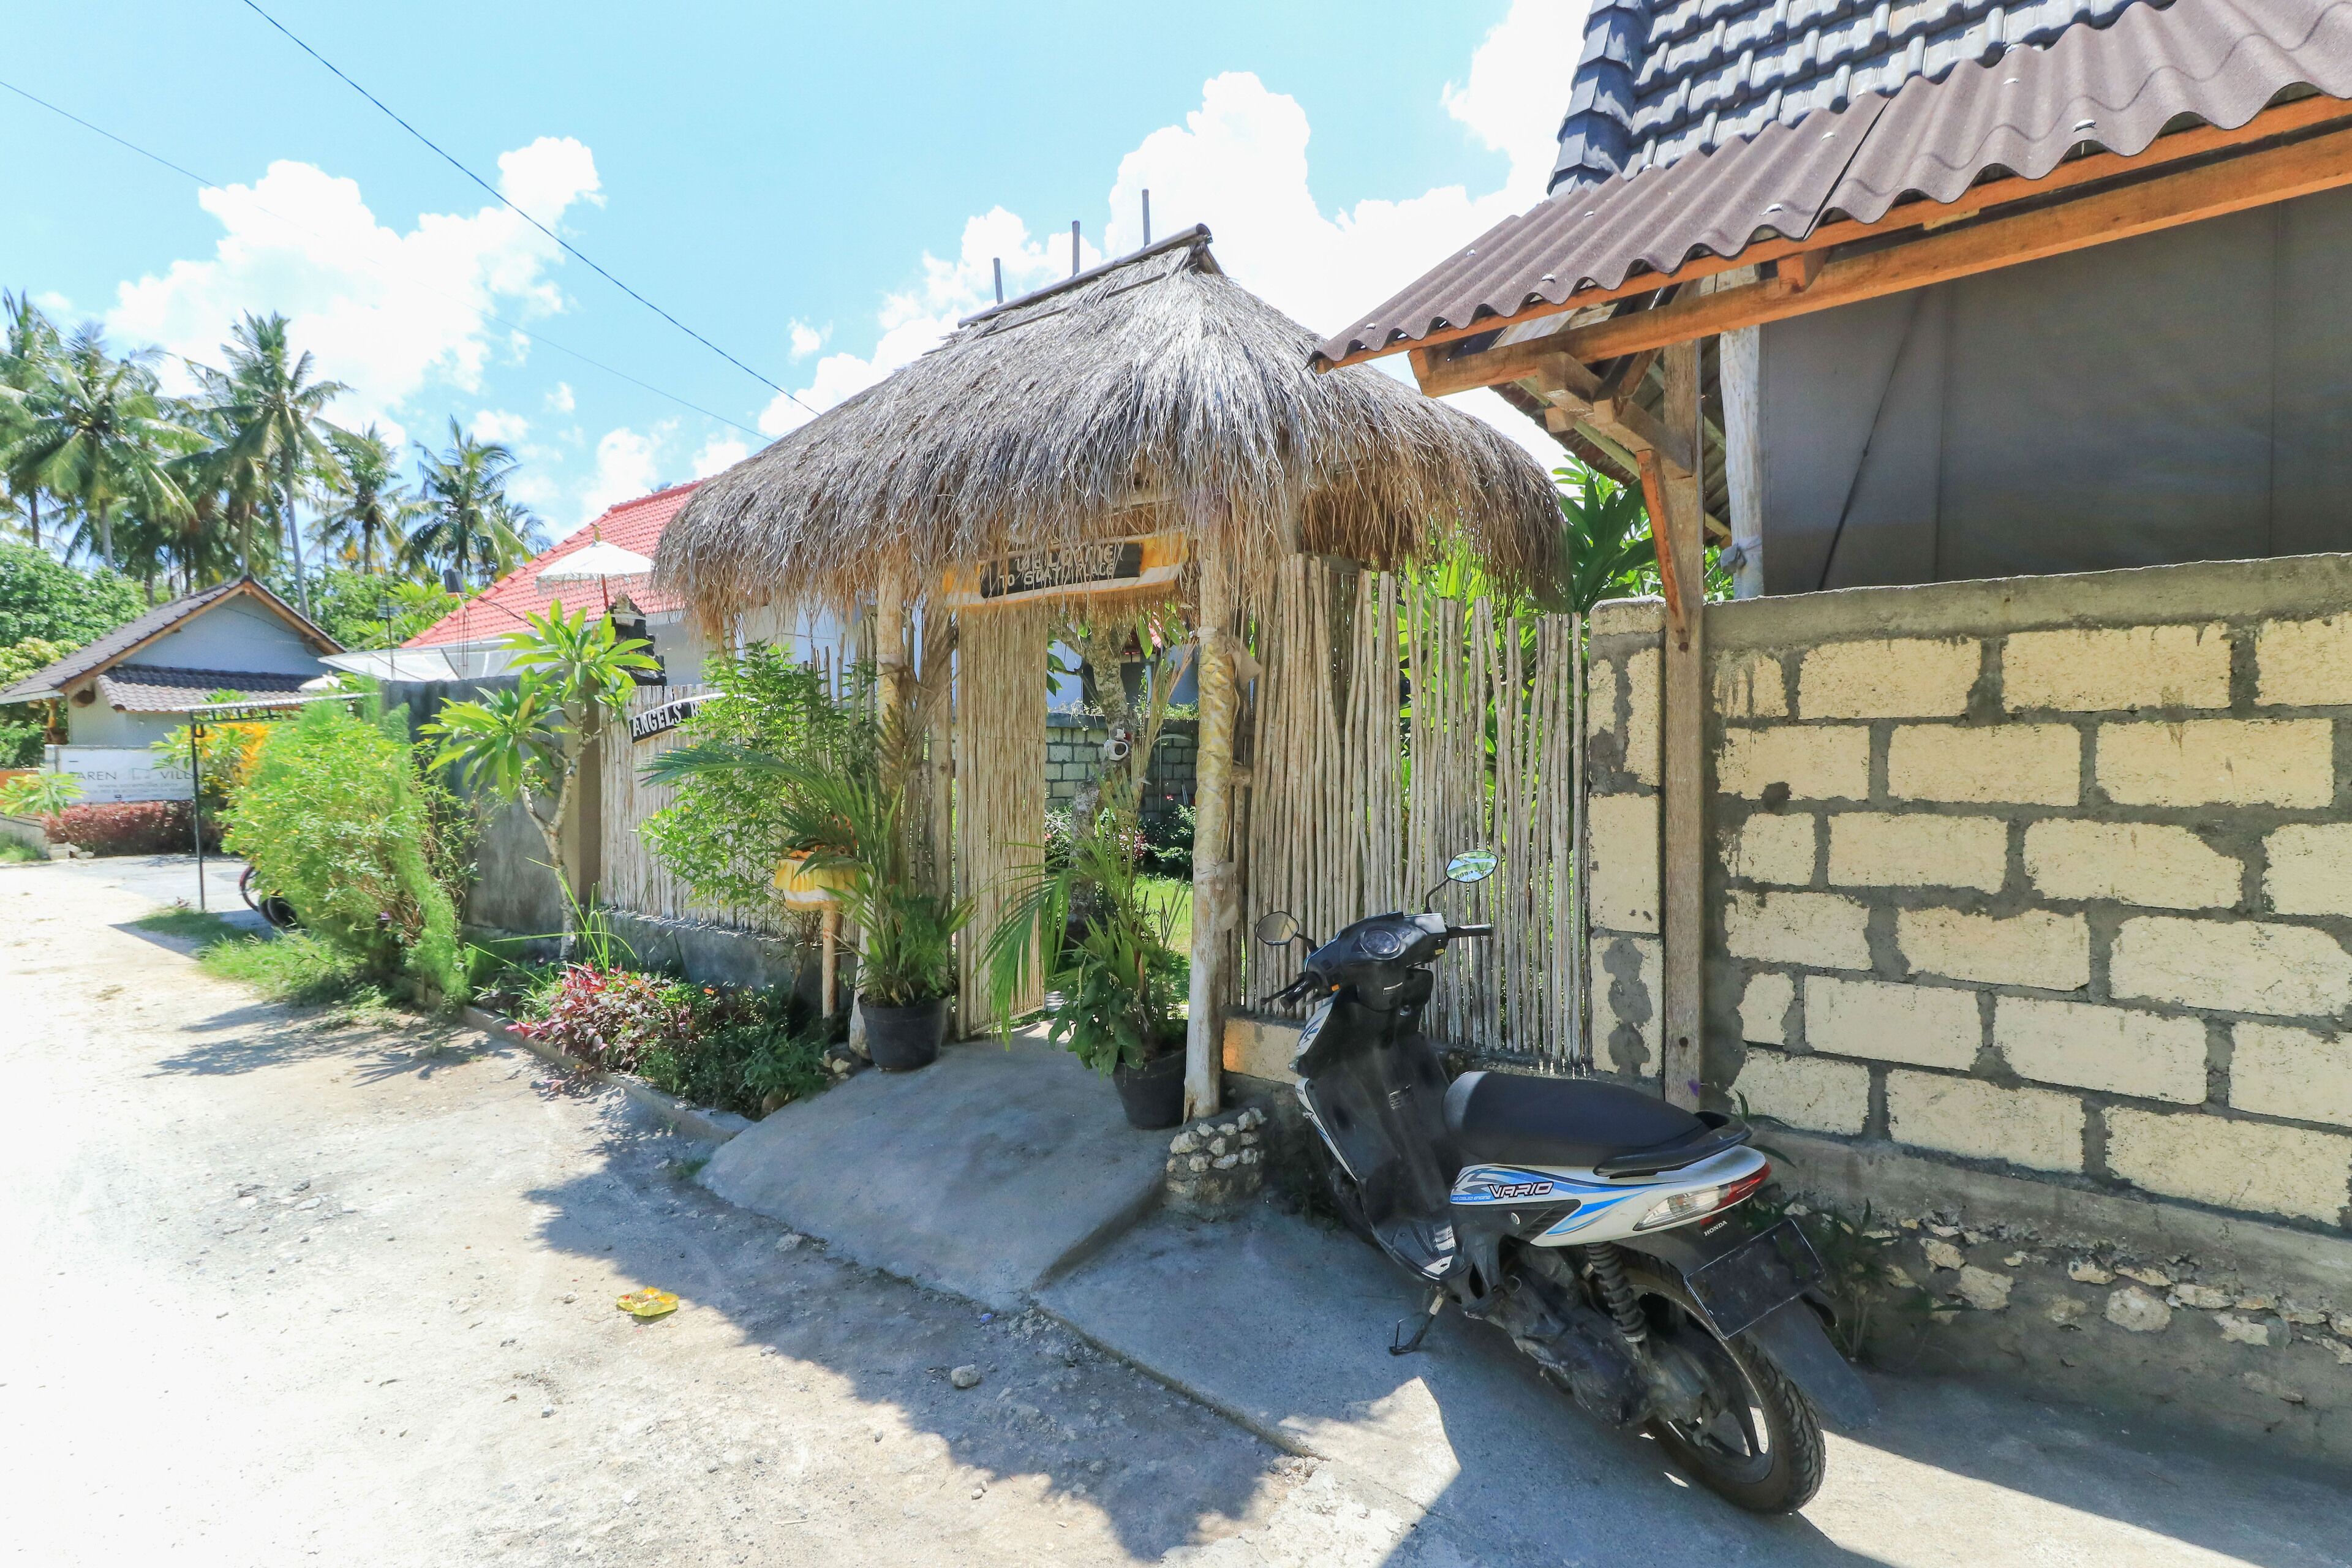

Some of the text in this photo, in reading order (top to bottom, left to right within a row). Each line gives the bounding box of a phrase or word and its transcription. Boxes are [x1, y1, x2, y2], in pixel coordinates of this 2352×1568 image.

[633, 703, 682, 737] ANGELS
[1488, 1181, 1554, 1199] VARIO
[1704, 1220, 1727, 1237] HONDA
